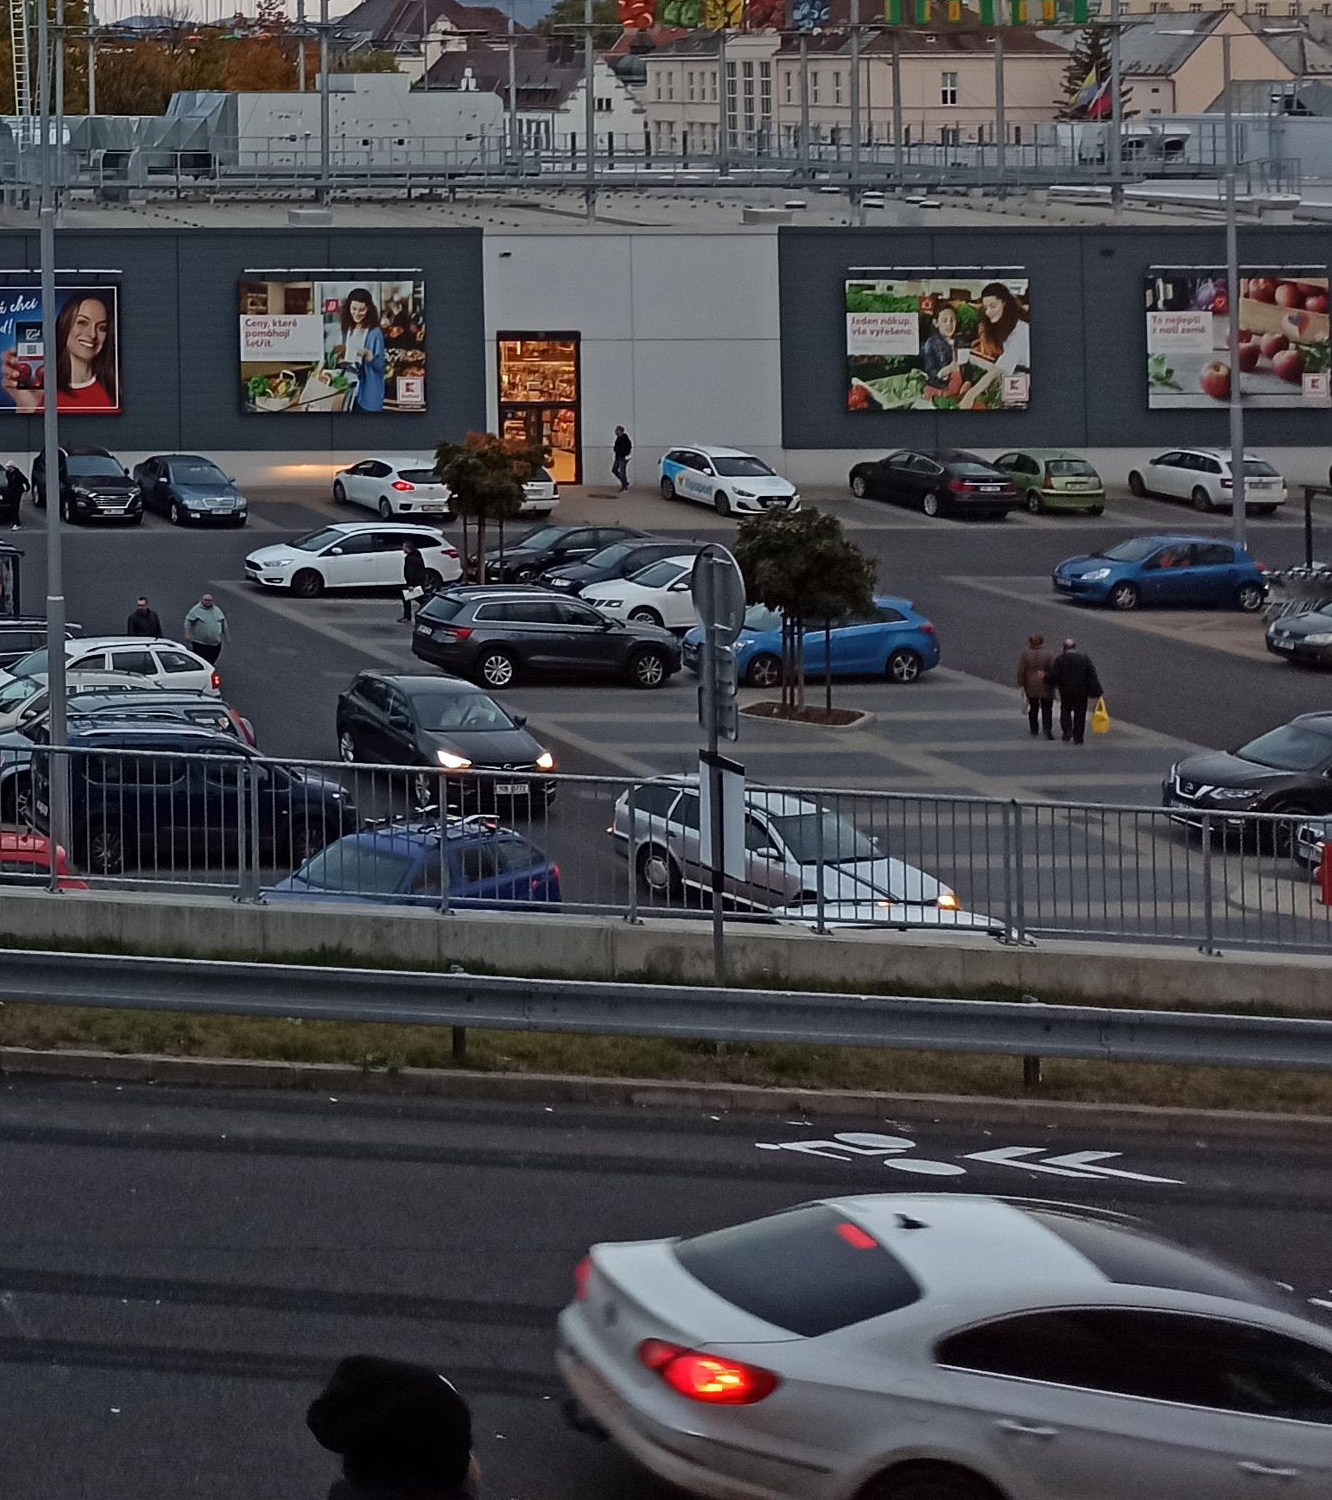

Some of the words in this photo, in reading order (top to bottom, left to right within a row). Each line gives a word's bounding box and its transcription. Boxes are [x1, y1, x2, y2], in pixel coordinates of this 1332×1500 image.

[10, 295, 38, 313] chci
[245, 318, 270, 329] Ceny,
[272, 318, 297, 327] které
[851, 316, 878, 325] Jeden
